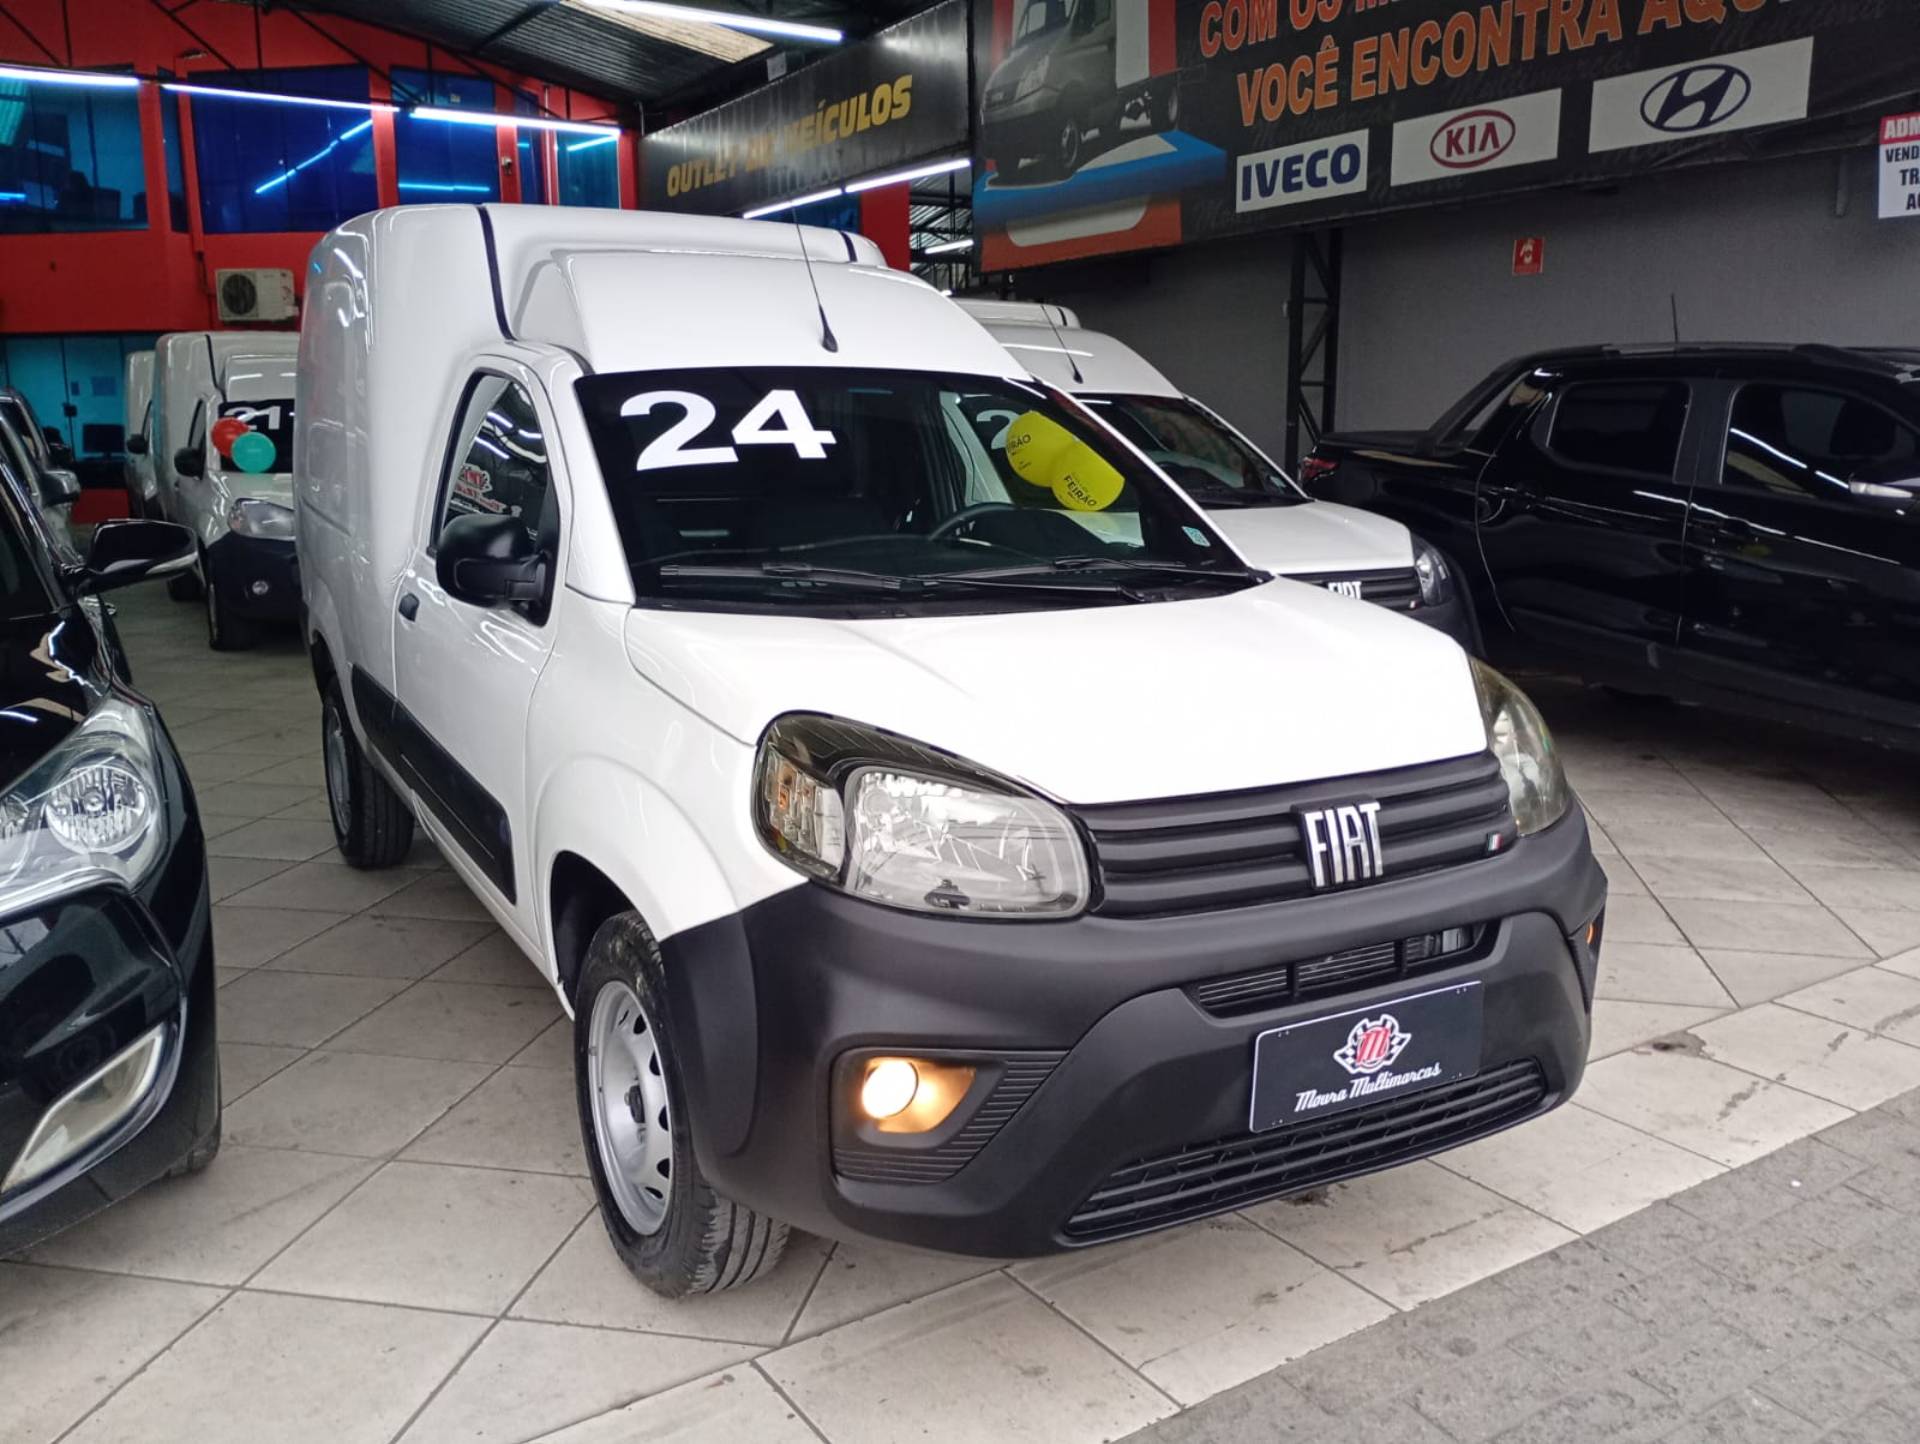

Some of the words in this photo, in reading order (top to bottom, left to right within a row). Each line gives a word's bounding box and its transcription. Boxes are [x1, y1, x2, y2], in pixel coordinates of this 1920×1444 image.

[1200, 0, 1277, 58] COM
[1237, 35, 1340, 127] VOCÊ
[1351, 0, 1622, 101] ENCONTRA
[1446, 121, 1500, 158] KIA
[1242, 143, 1361, 201] IVECO
[1906, 193, 1920, 211] A
[224, 406, 281, 430] 21
[620, 389, 837, 471] 24
[1304, 801, 1383, 888] FIAT
[1294, 1089, 1348, 1112] Moura
[1349, 1062, 1442, 1098] Multimarcas
